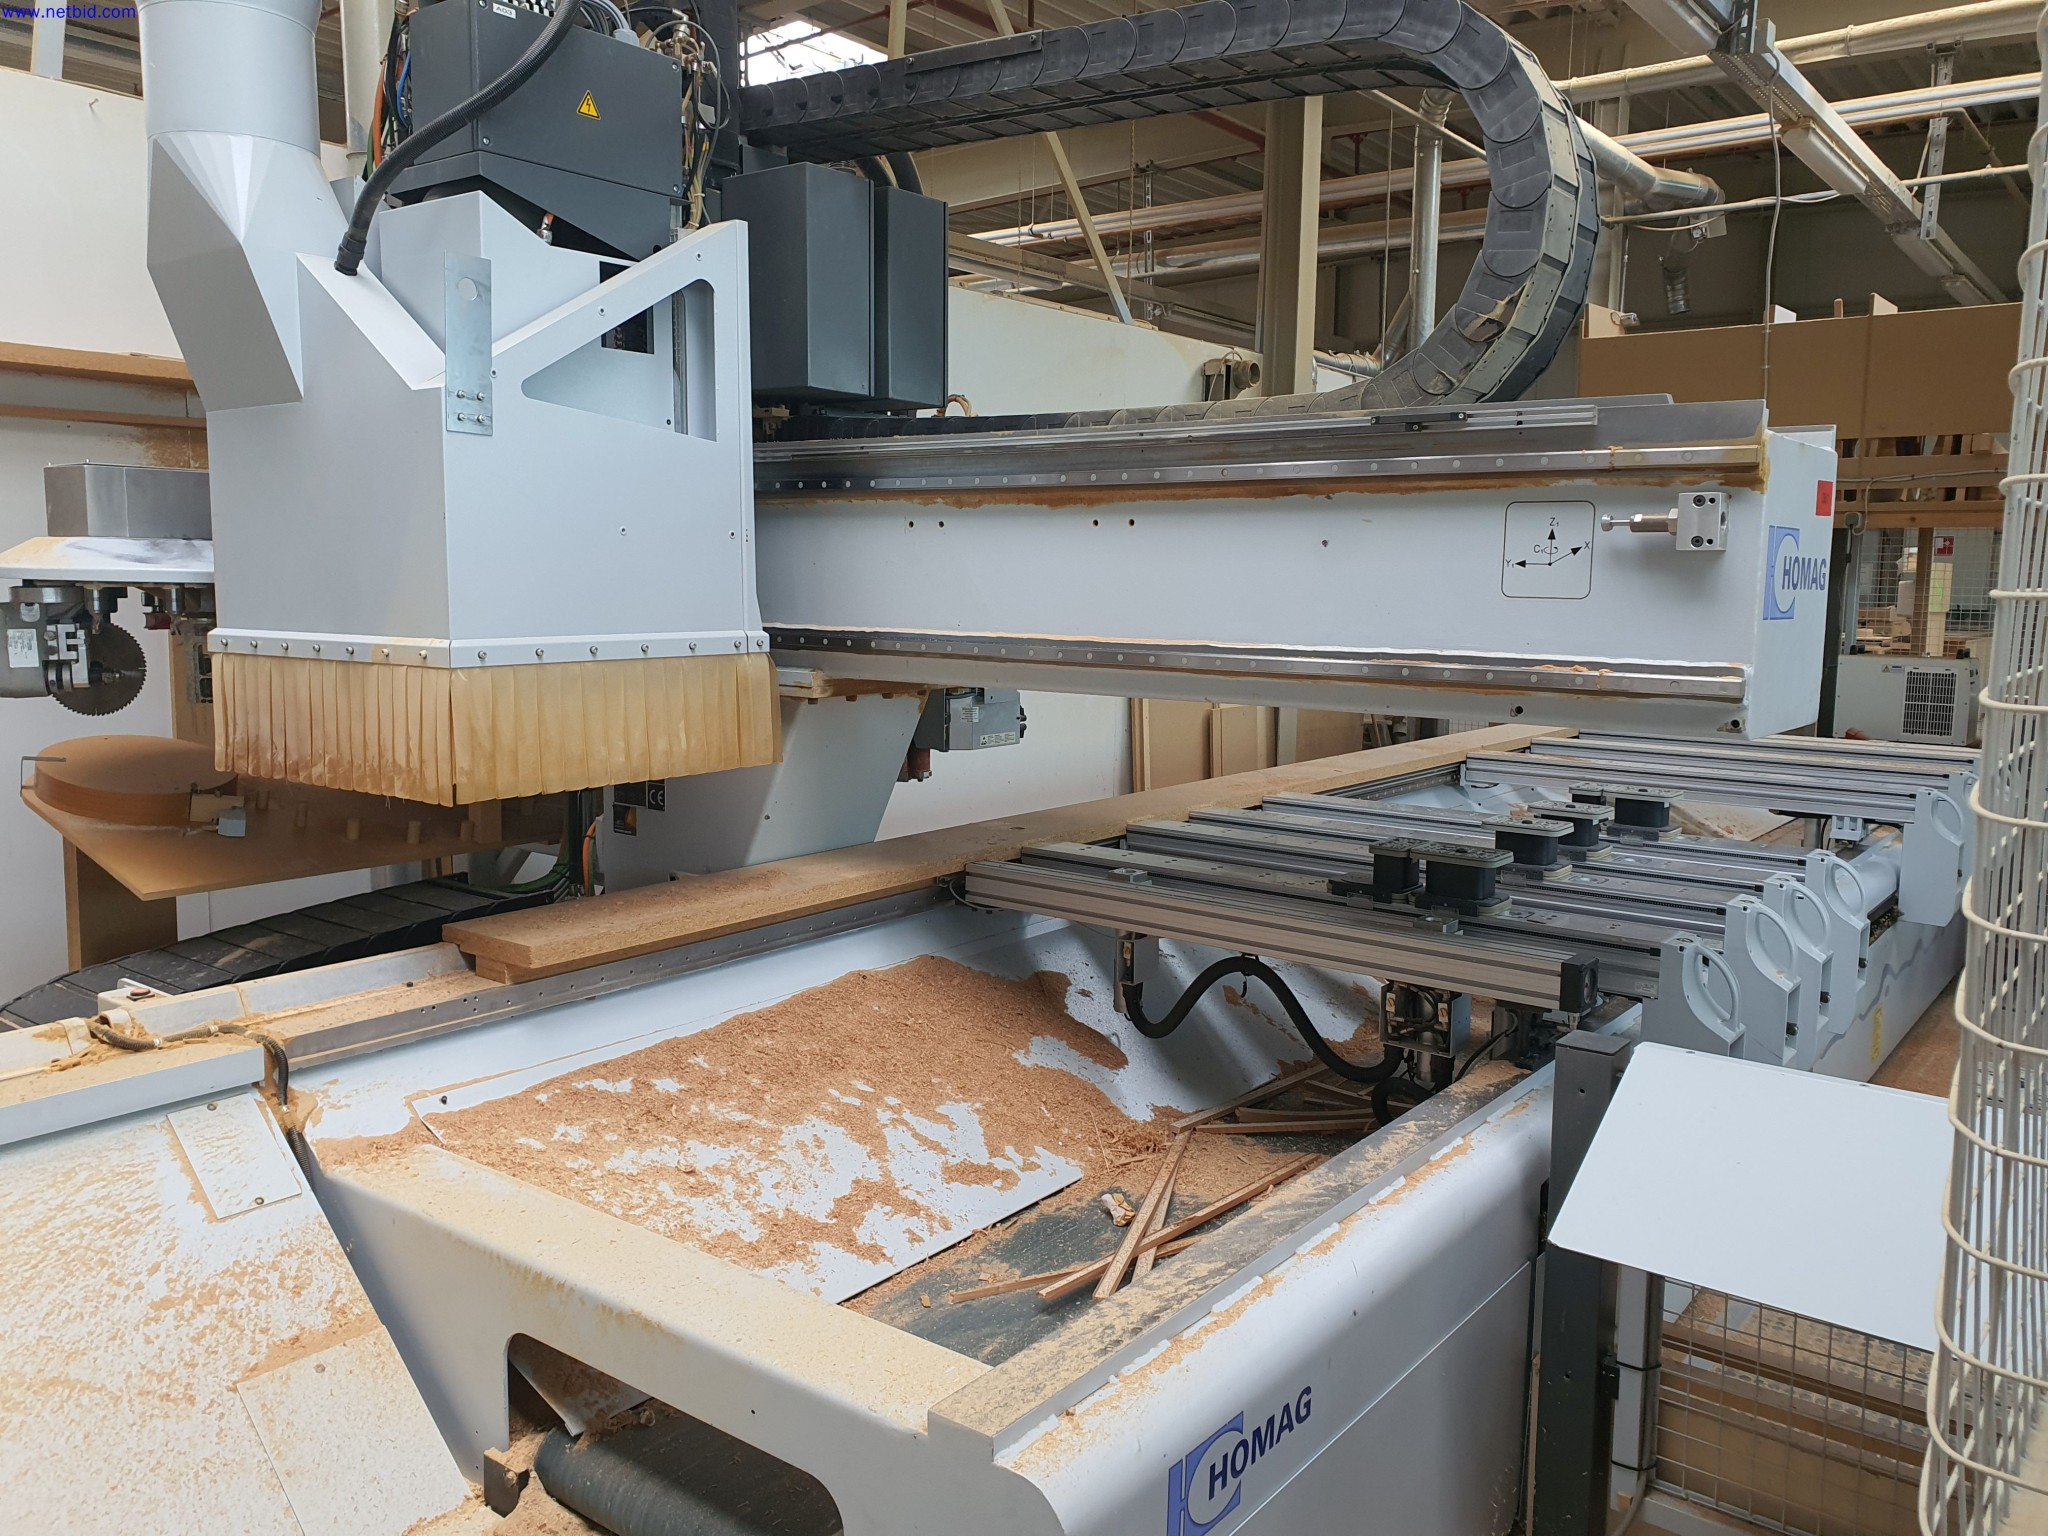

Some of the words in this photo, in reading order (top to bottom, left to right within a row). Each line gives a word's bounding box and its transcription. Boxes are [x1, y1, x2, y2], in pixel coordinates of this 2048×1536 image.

[1584, 541, 1591, 550] X
[1782, 556, 1827, 590] HOMAG
[1208, 1386, 1312, 1501] HOMAG
